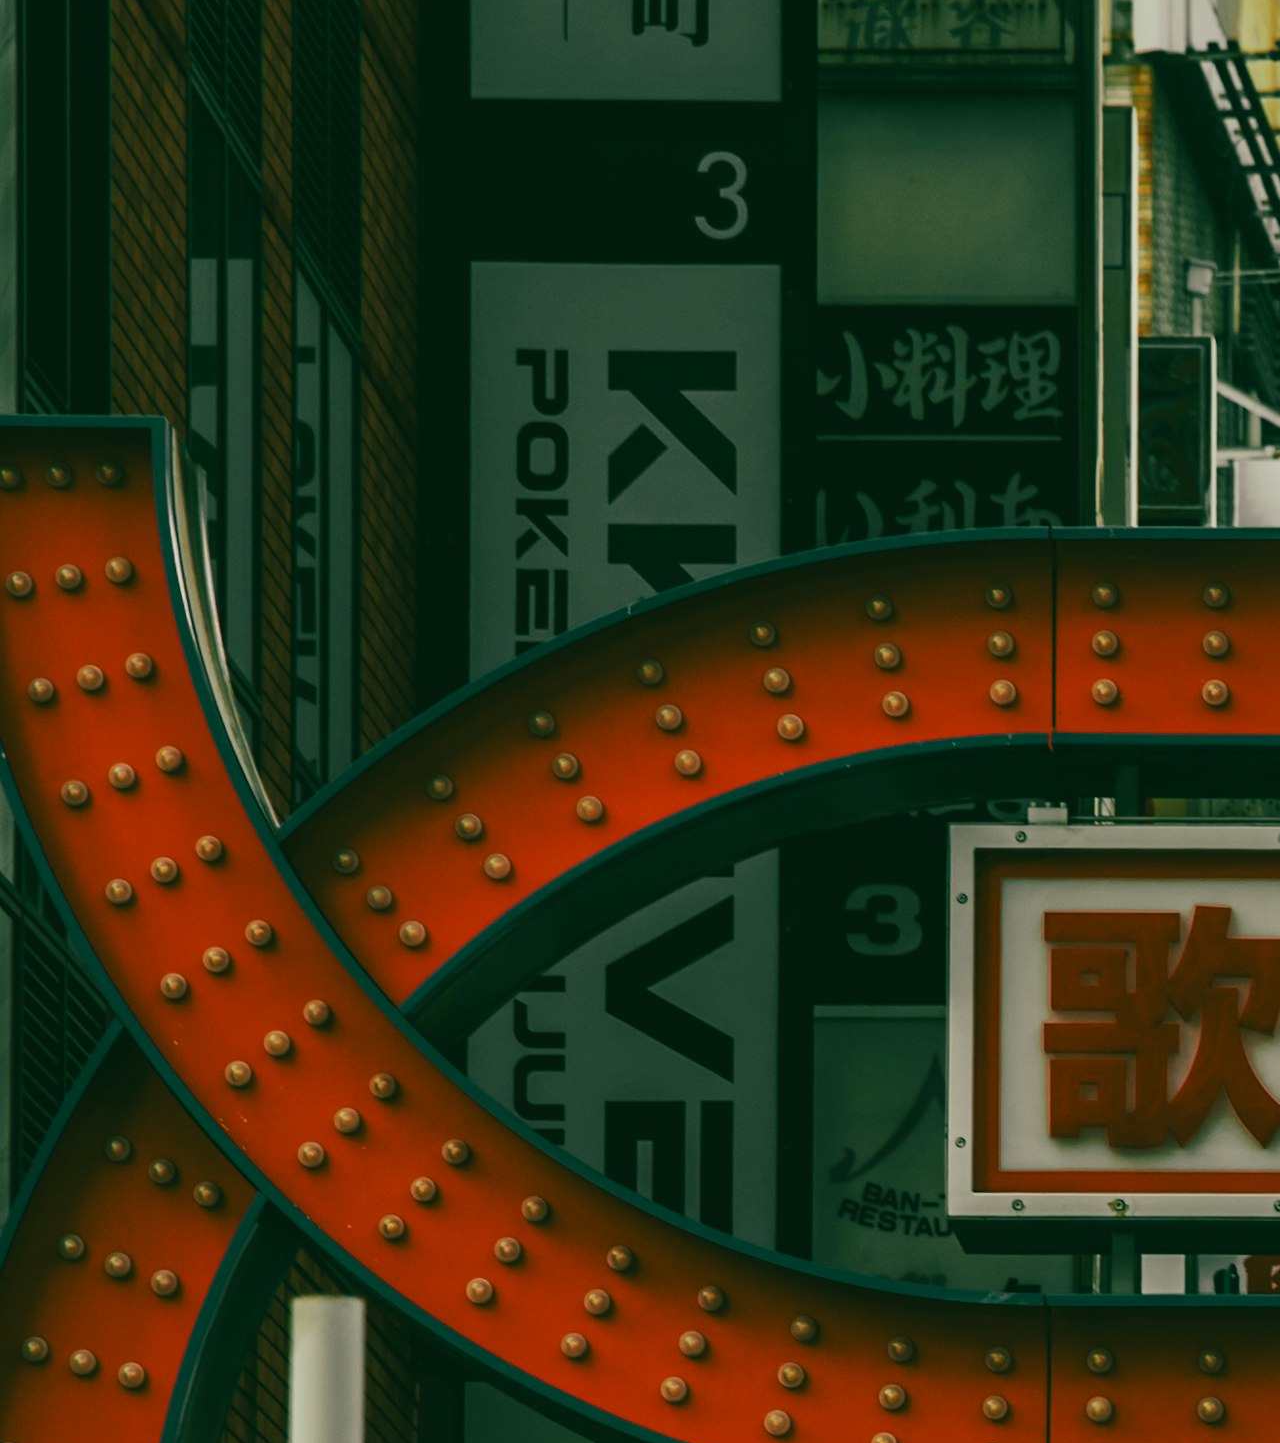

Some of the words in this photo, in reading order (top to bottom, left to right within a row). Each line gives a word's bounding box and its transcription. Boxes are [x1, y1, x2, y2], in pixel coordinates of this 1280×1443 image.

[694, 152, 748, 240] 3
[817, 325, 1062, 427] 小料理
[515, 350, 568, 655] POKE
